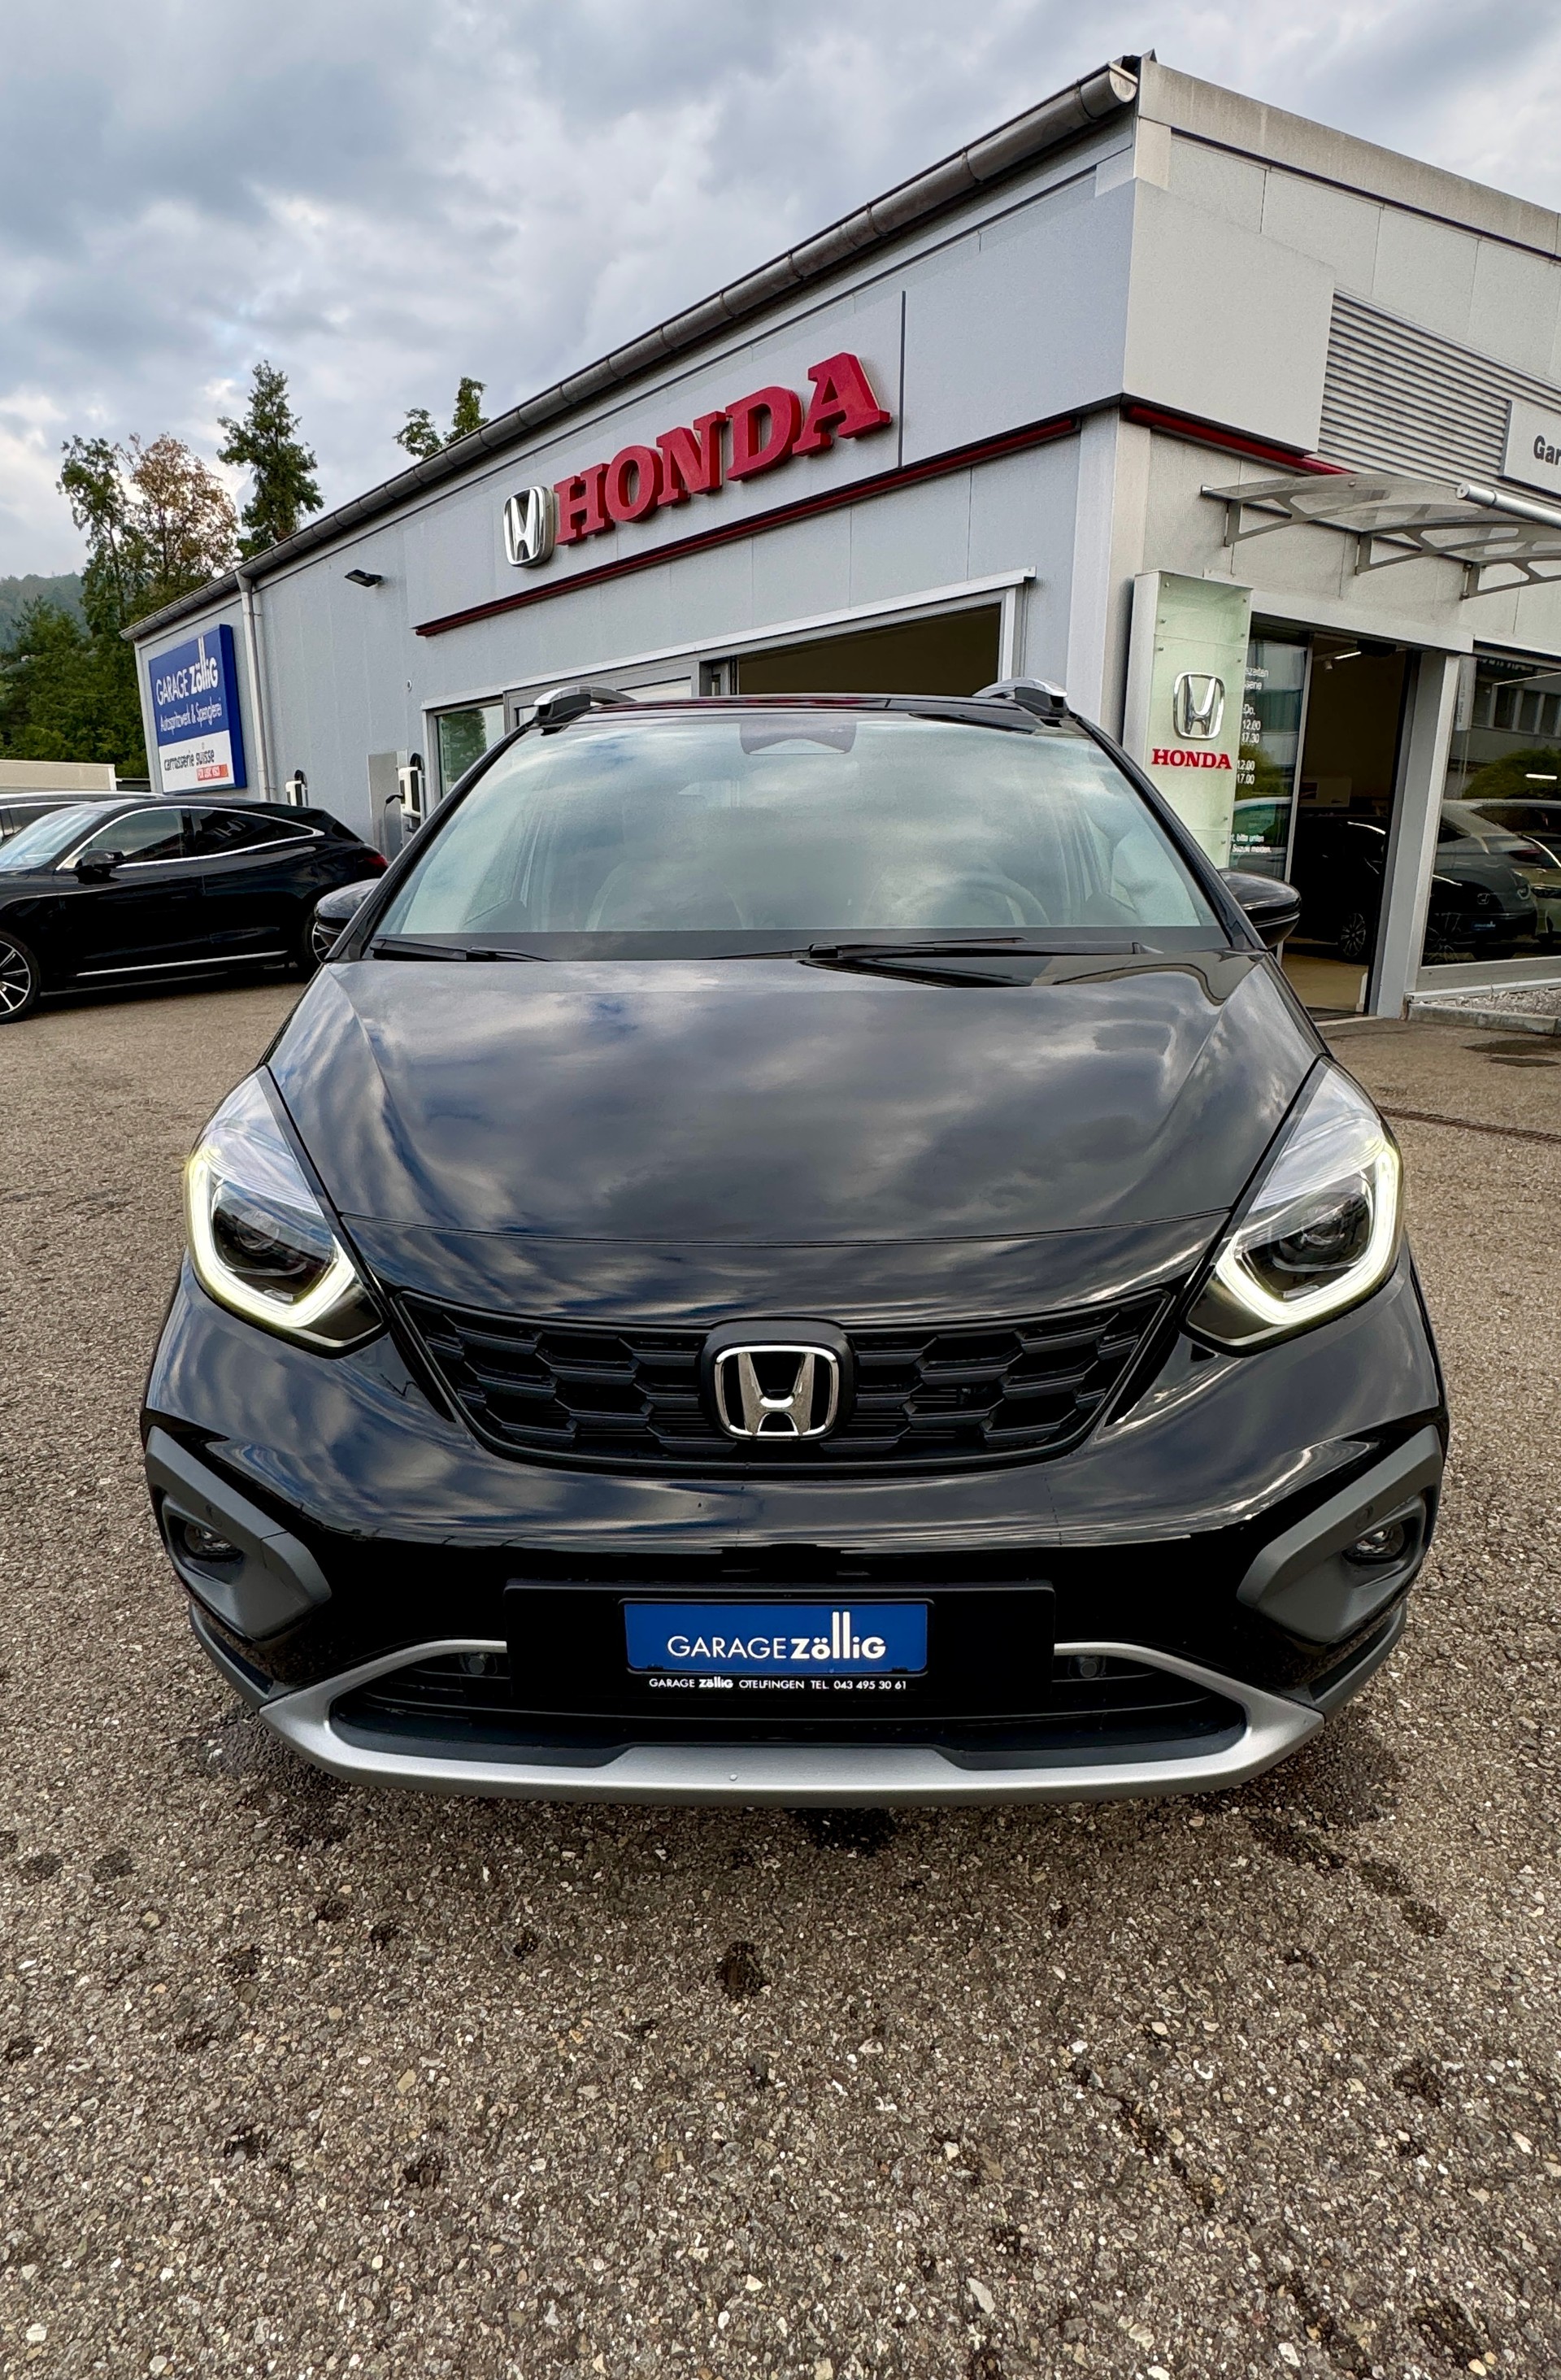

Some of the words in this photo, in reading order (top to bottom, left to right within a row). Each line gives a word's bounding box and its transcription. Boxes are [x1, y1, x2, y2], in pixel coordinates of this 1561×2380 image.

[554, 352, 892, 546] HONDA
[156, 668, 188, 705] GARAGE
[1151, 748, 1232, 769] HONDA
[667, 1635, 787, 1659] GARAGE
[649, 1678, 695, 1688] GARAGE
[738, 1679, 805, 1690] OTELFINGEN
[833, 1680, 854, 1690] 043
[856, 1680, 876, 1690] 495
[878, 1680, 892, 1690] 30
[894, 1680, 907, 1690] 61
